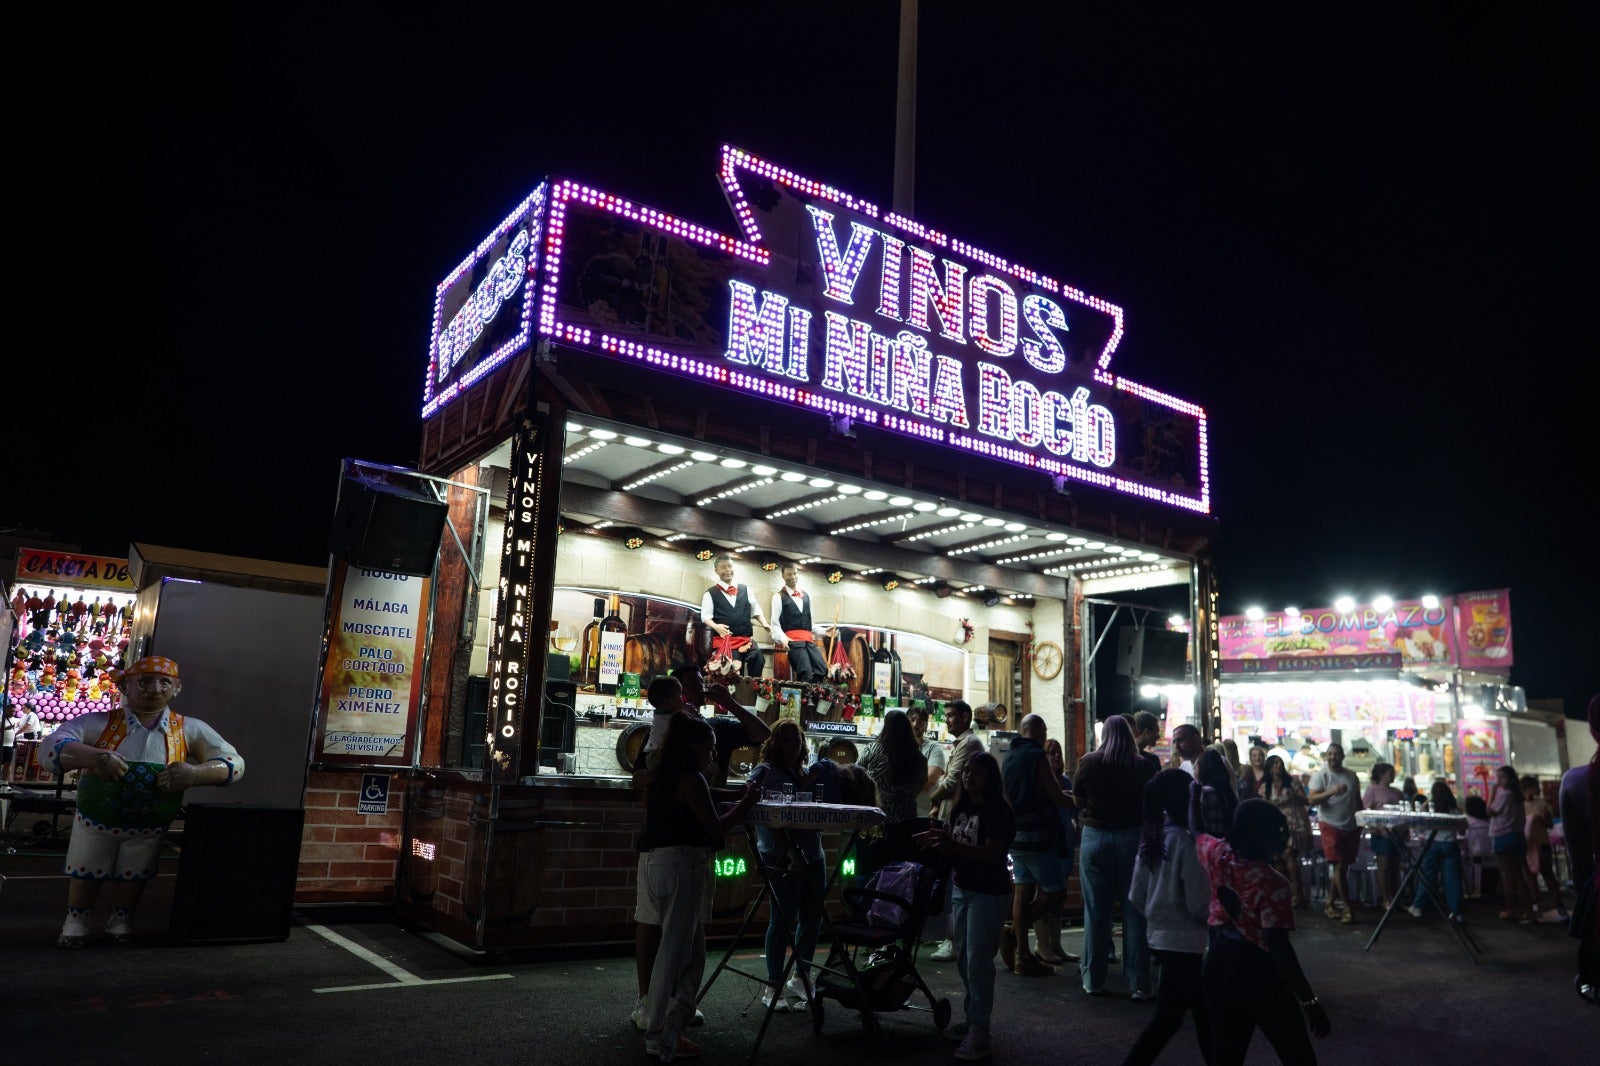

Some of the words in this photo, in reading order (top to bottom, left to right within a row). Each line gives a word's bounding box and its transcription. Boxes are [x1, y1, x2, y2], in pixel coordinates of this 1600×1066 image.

[805, 203, 1069, 374] VINOS
[437, 229, 530, 382] VINOS
[724, 279, 813, 383] MI
[821, 311, 970, 429] NIÑA
[977, 361, 1116, 469] ROCÍO
[521, 452, 538, 523] VINOS
[505, 476, 518, 556] VINOS
[517, 539, 531, 567] MI
[26, 554, 98, 579] CASETA
[103, 562, 129, 581] DE
[353, 597, 409, 615] MÁLAGA
[509, 584, 528, 643] NIÑA
[343, 621, 412, 639] MOSCATEL
[1263, 615, 1292, 638] EL
[1300, 605, 1446, 635] BOMBAZO
[359, 646, 393, 661] PALO
[343, 659, 405, 674] CORTADO
[491, 624, 505, 708] VINOS
[348, 686, 393, 700] PEDRO
[501, 661, 520, 738] ROCIO
[337, 699, 401, 714] XIMÉNEZ
[809, 722, 825, 731] PALO
[826, 723, 856, 732] CORTADO
[342, 735, 400, 745] AGRADECEMOS
[345, 743, 357, 751] SU
[358, 744, 384, 752] VISITA
[360, 802, 385, 813] PARKING
[781, 809, 805, 823] PALO
[807, 810, 850, 824] CORTADO
